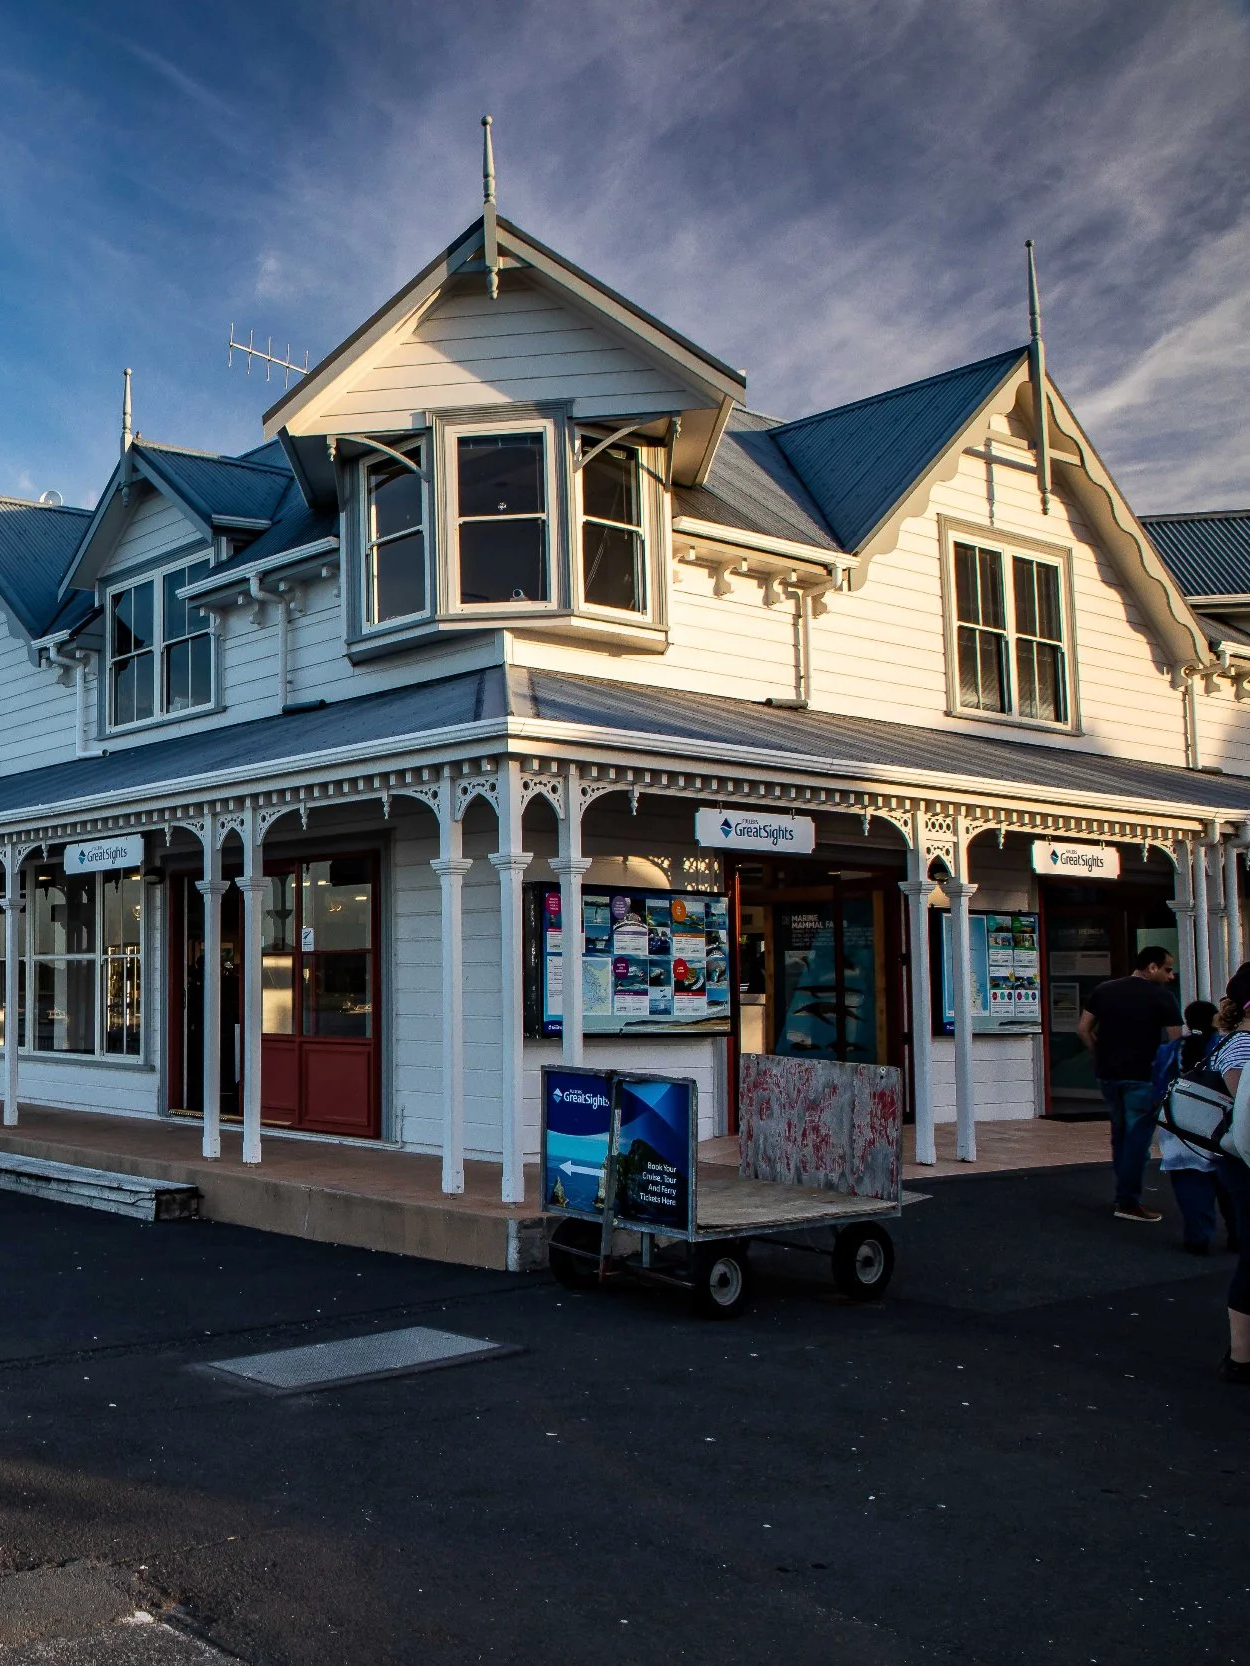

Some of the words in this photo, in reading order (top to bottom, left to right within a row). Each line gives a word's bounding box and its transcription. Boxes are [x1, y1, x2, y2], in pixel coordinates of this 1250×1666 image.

[734, 822, 794, 846] GreatSights
[87, 846, 128, 864] GreatSights
[1060, 852, 1104, 872] GreatSights
[647, 1161, 663, 1171] Book
[663, 1164, 677, 1173] Your
[663, 1174, 677, 1184] Tour
[647, 1183, 661, 1193] And
[661, 1185, 677, 1196] Ferry
[639, 1192, 661, 1203] Tickets
[661, 1196, 677, 1206] Here
